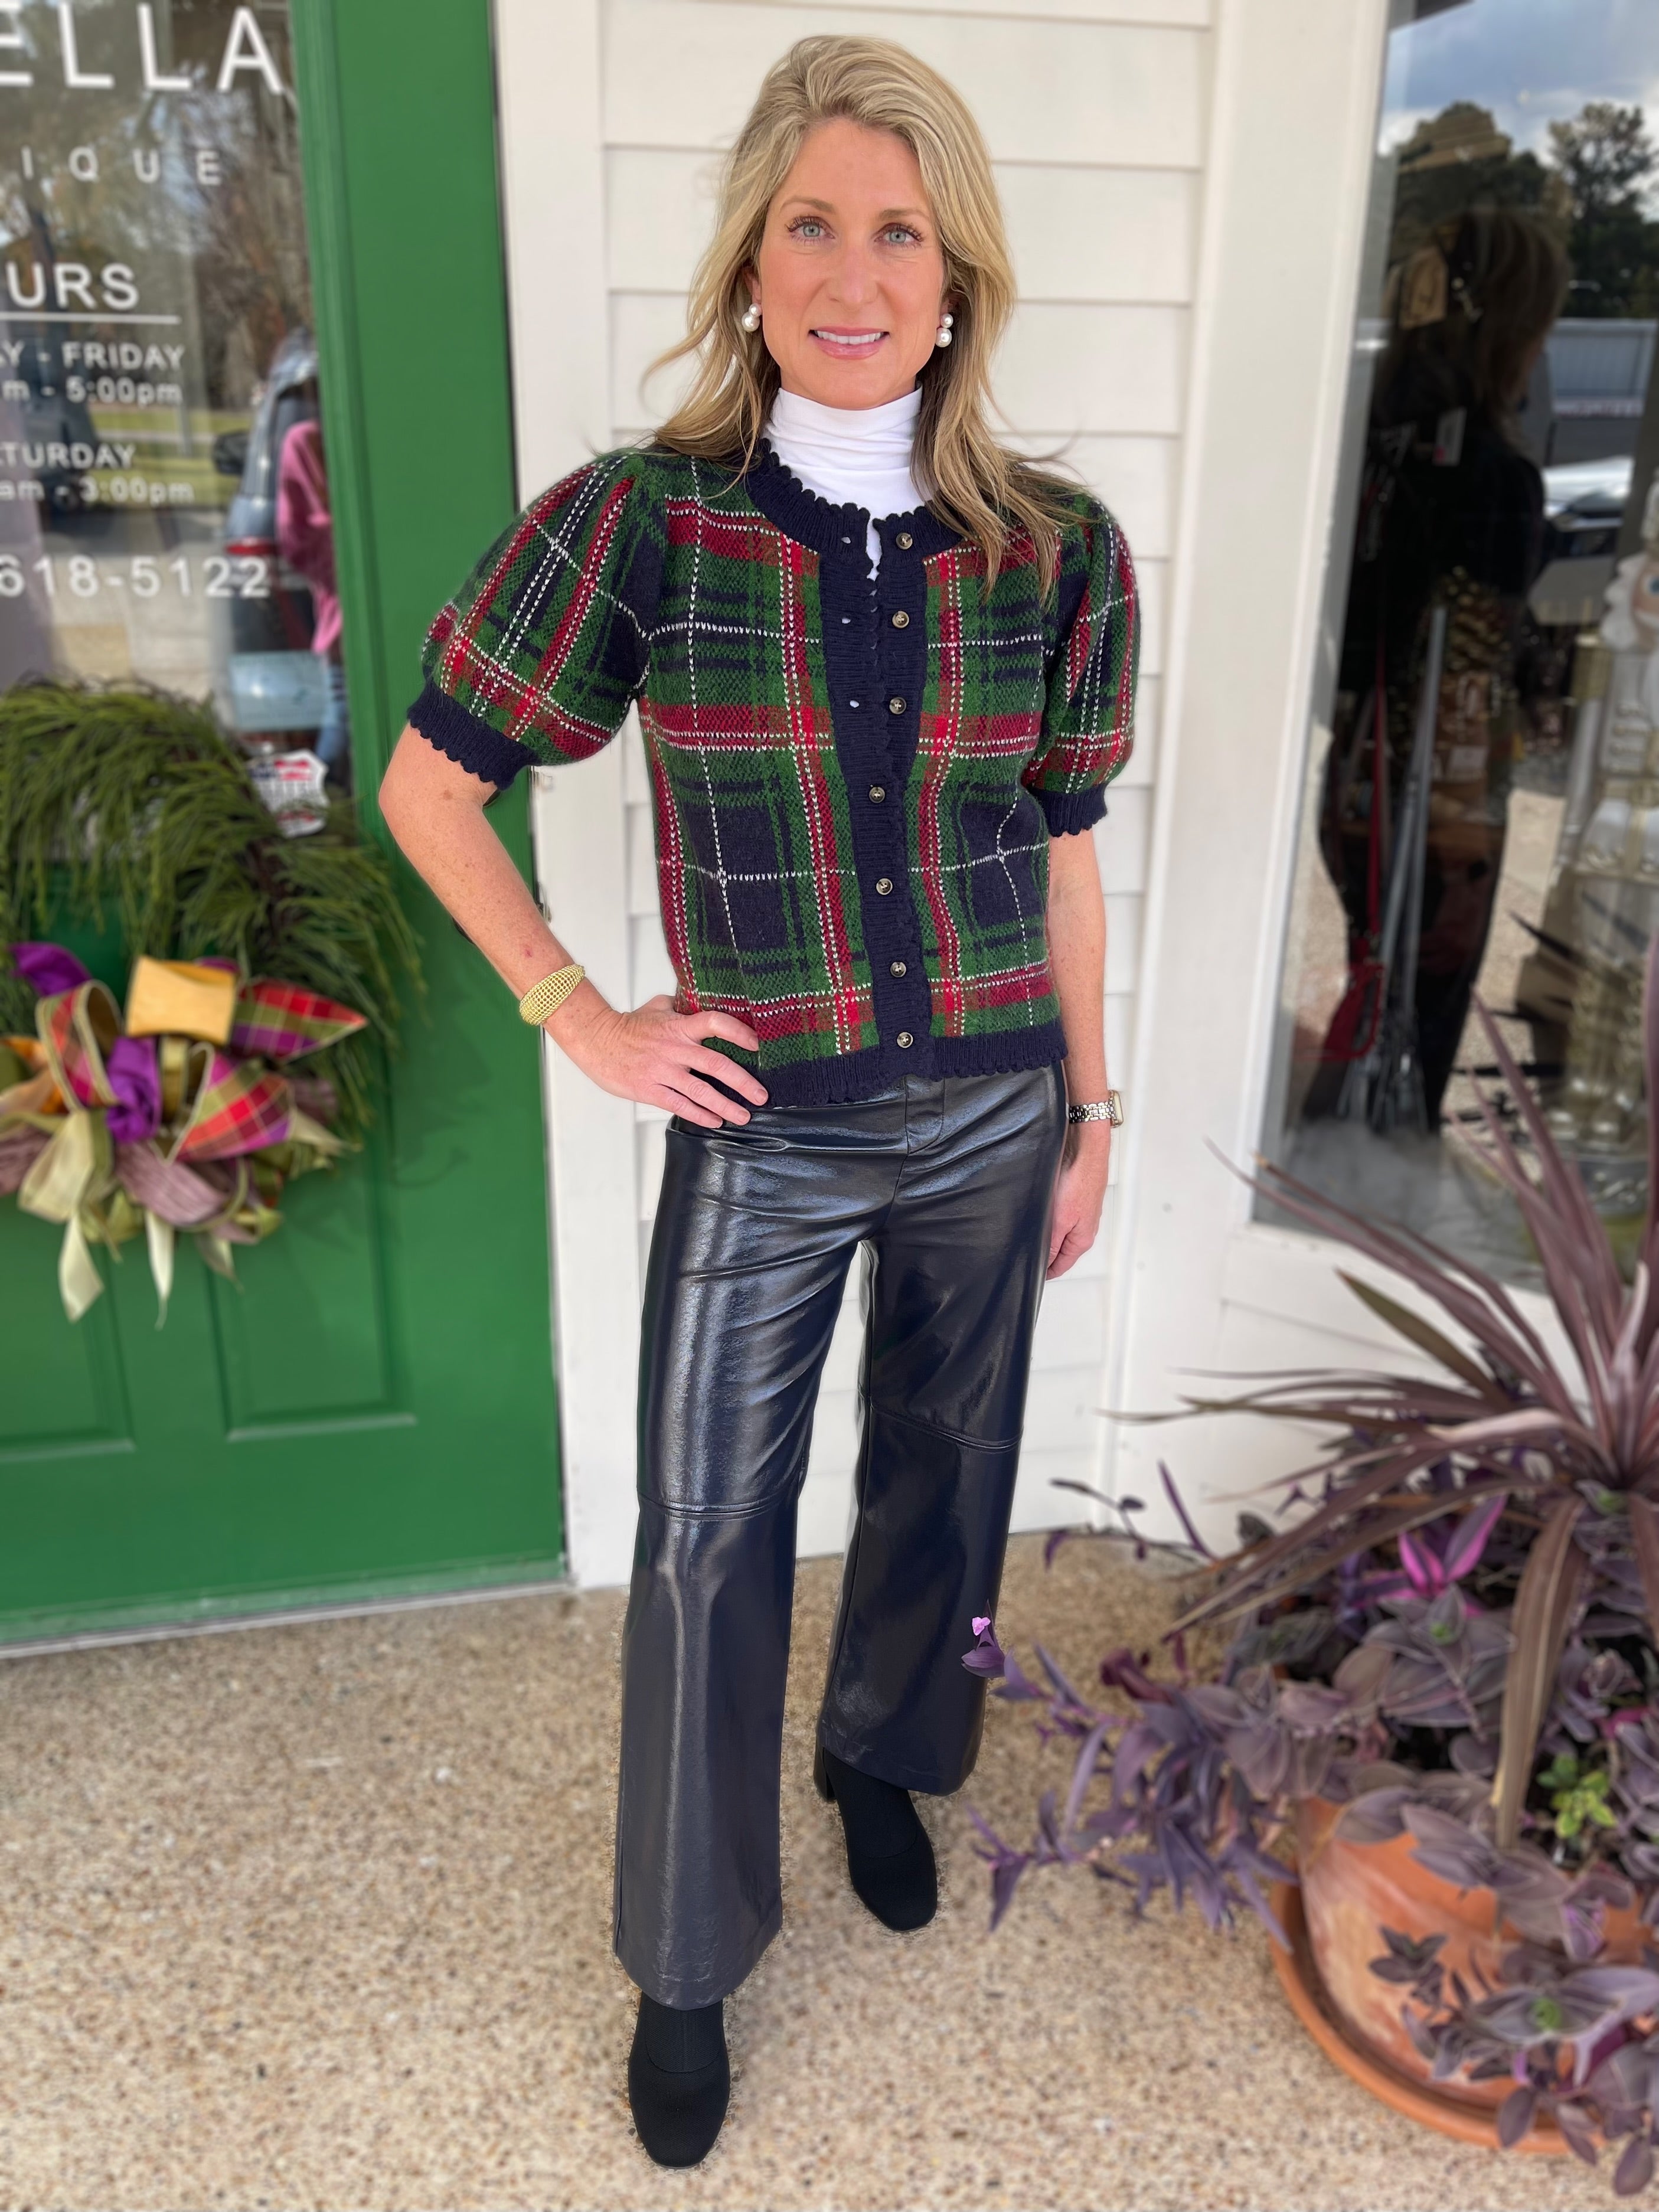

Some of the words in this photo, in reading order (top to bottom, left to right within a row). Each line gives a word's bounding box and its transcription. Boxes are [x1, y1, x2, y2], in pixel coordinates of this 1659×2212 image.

[21, 145, 223, 185] IQUE
[6, 262, 139, 310] URS
[61, 341, 184, 370] FRIDAY
[66, 375, 183, 406] 5:00pm
[0, 442, 136, 470] TURDAY
[79, 476, 195, 506] 3:00pm
[0, 554, 270, 597] 618-5122
